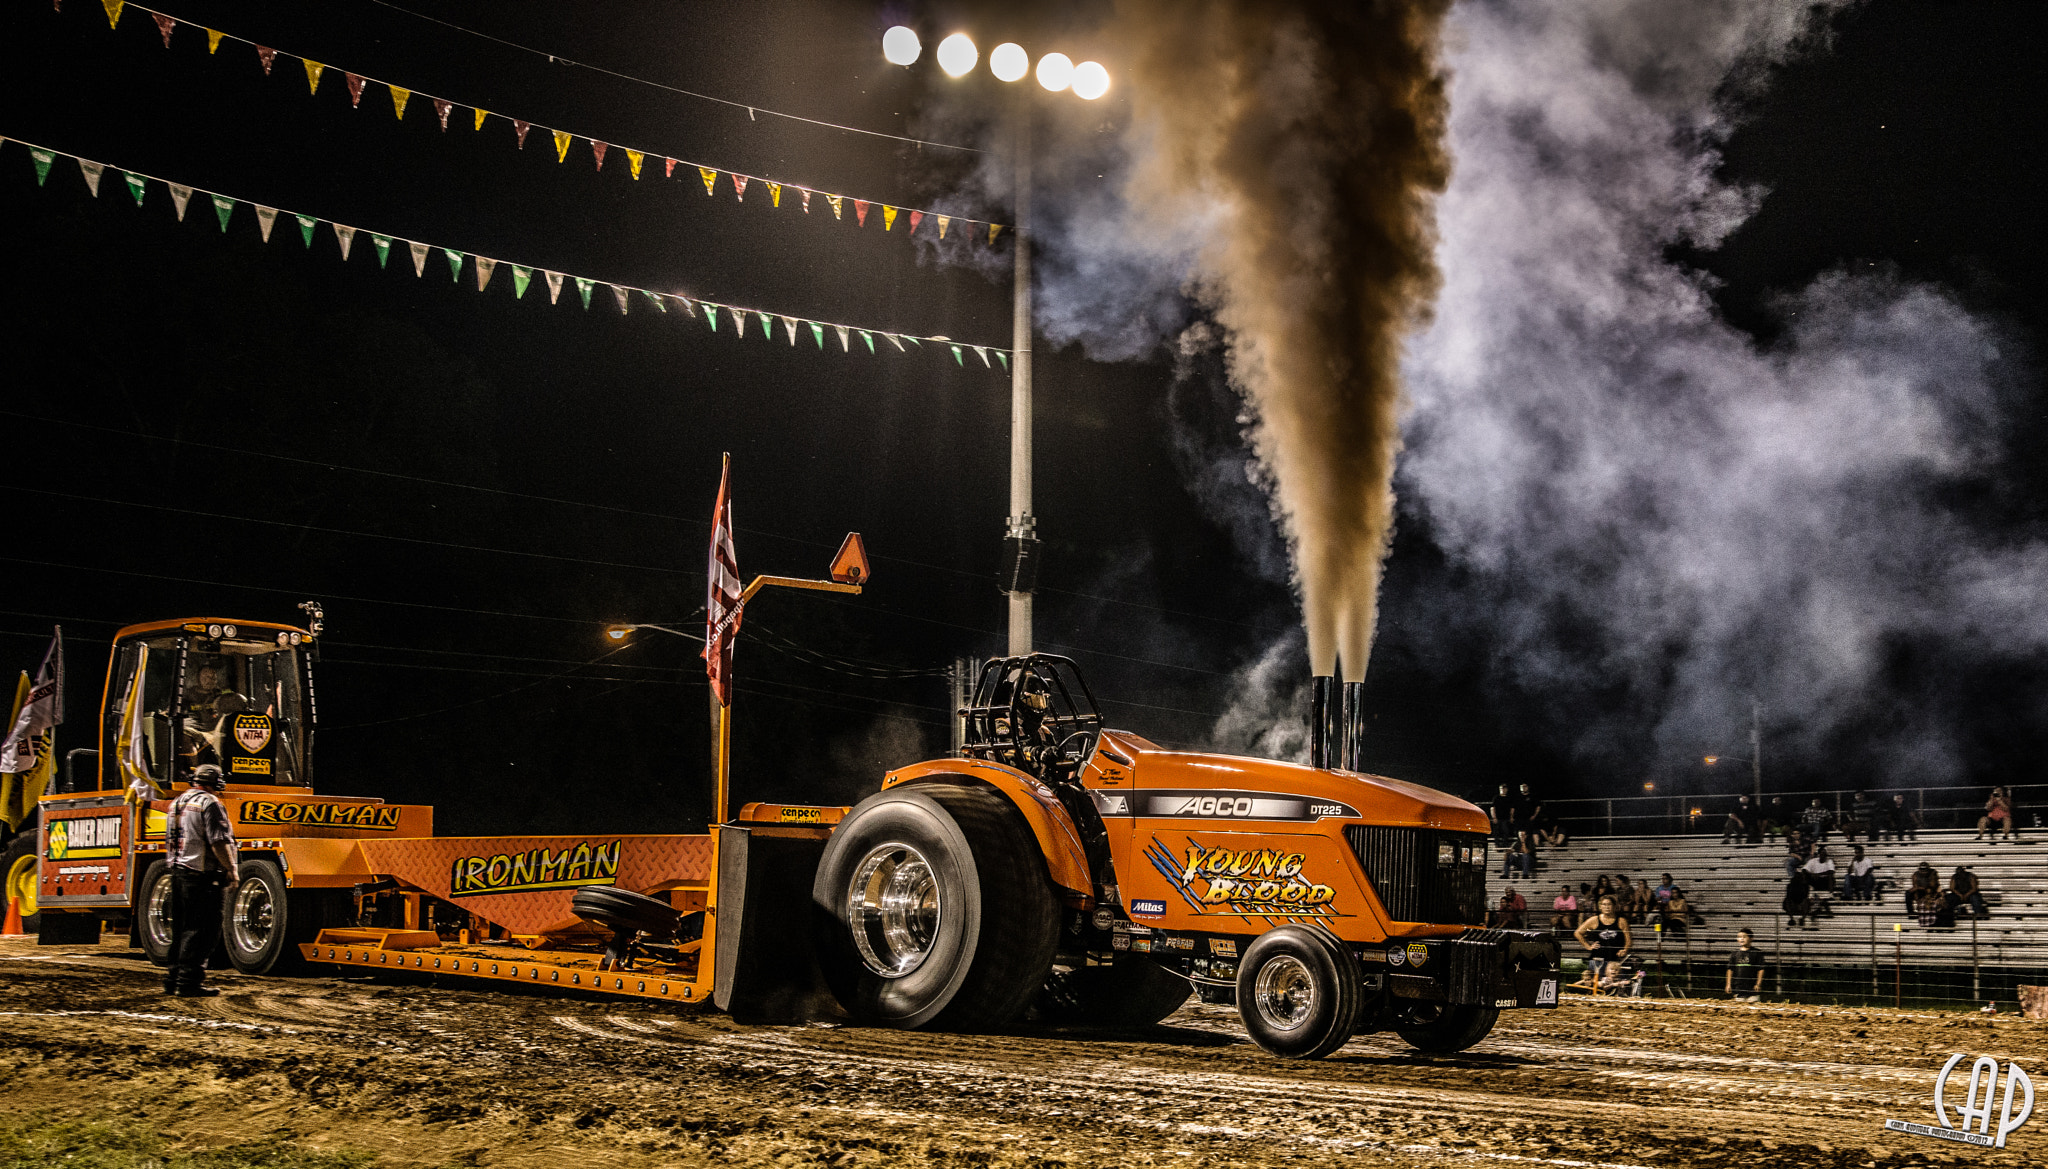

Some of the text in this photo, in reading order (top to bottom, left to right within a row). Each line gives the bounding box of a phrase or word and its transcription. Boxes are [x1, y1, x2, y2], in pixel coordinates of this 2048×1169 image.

[243, 729, 264, 740] NTPA
[240, 801, 401, 826] IRONMAN
[1176, 797, 1342, 816] AGCO DT225
[68, 817, 122, 847] BAUER BUILT
[451, 840, 621, 891] IRONMAN
[1182, 846, 1305, 887] YOUNG
[1201, 878, 1337, 905] BLOOD
[1133, 902, 1164, 912] Mitas
[1542, 985, 1552, 998] 16
